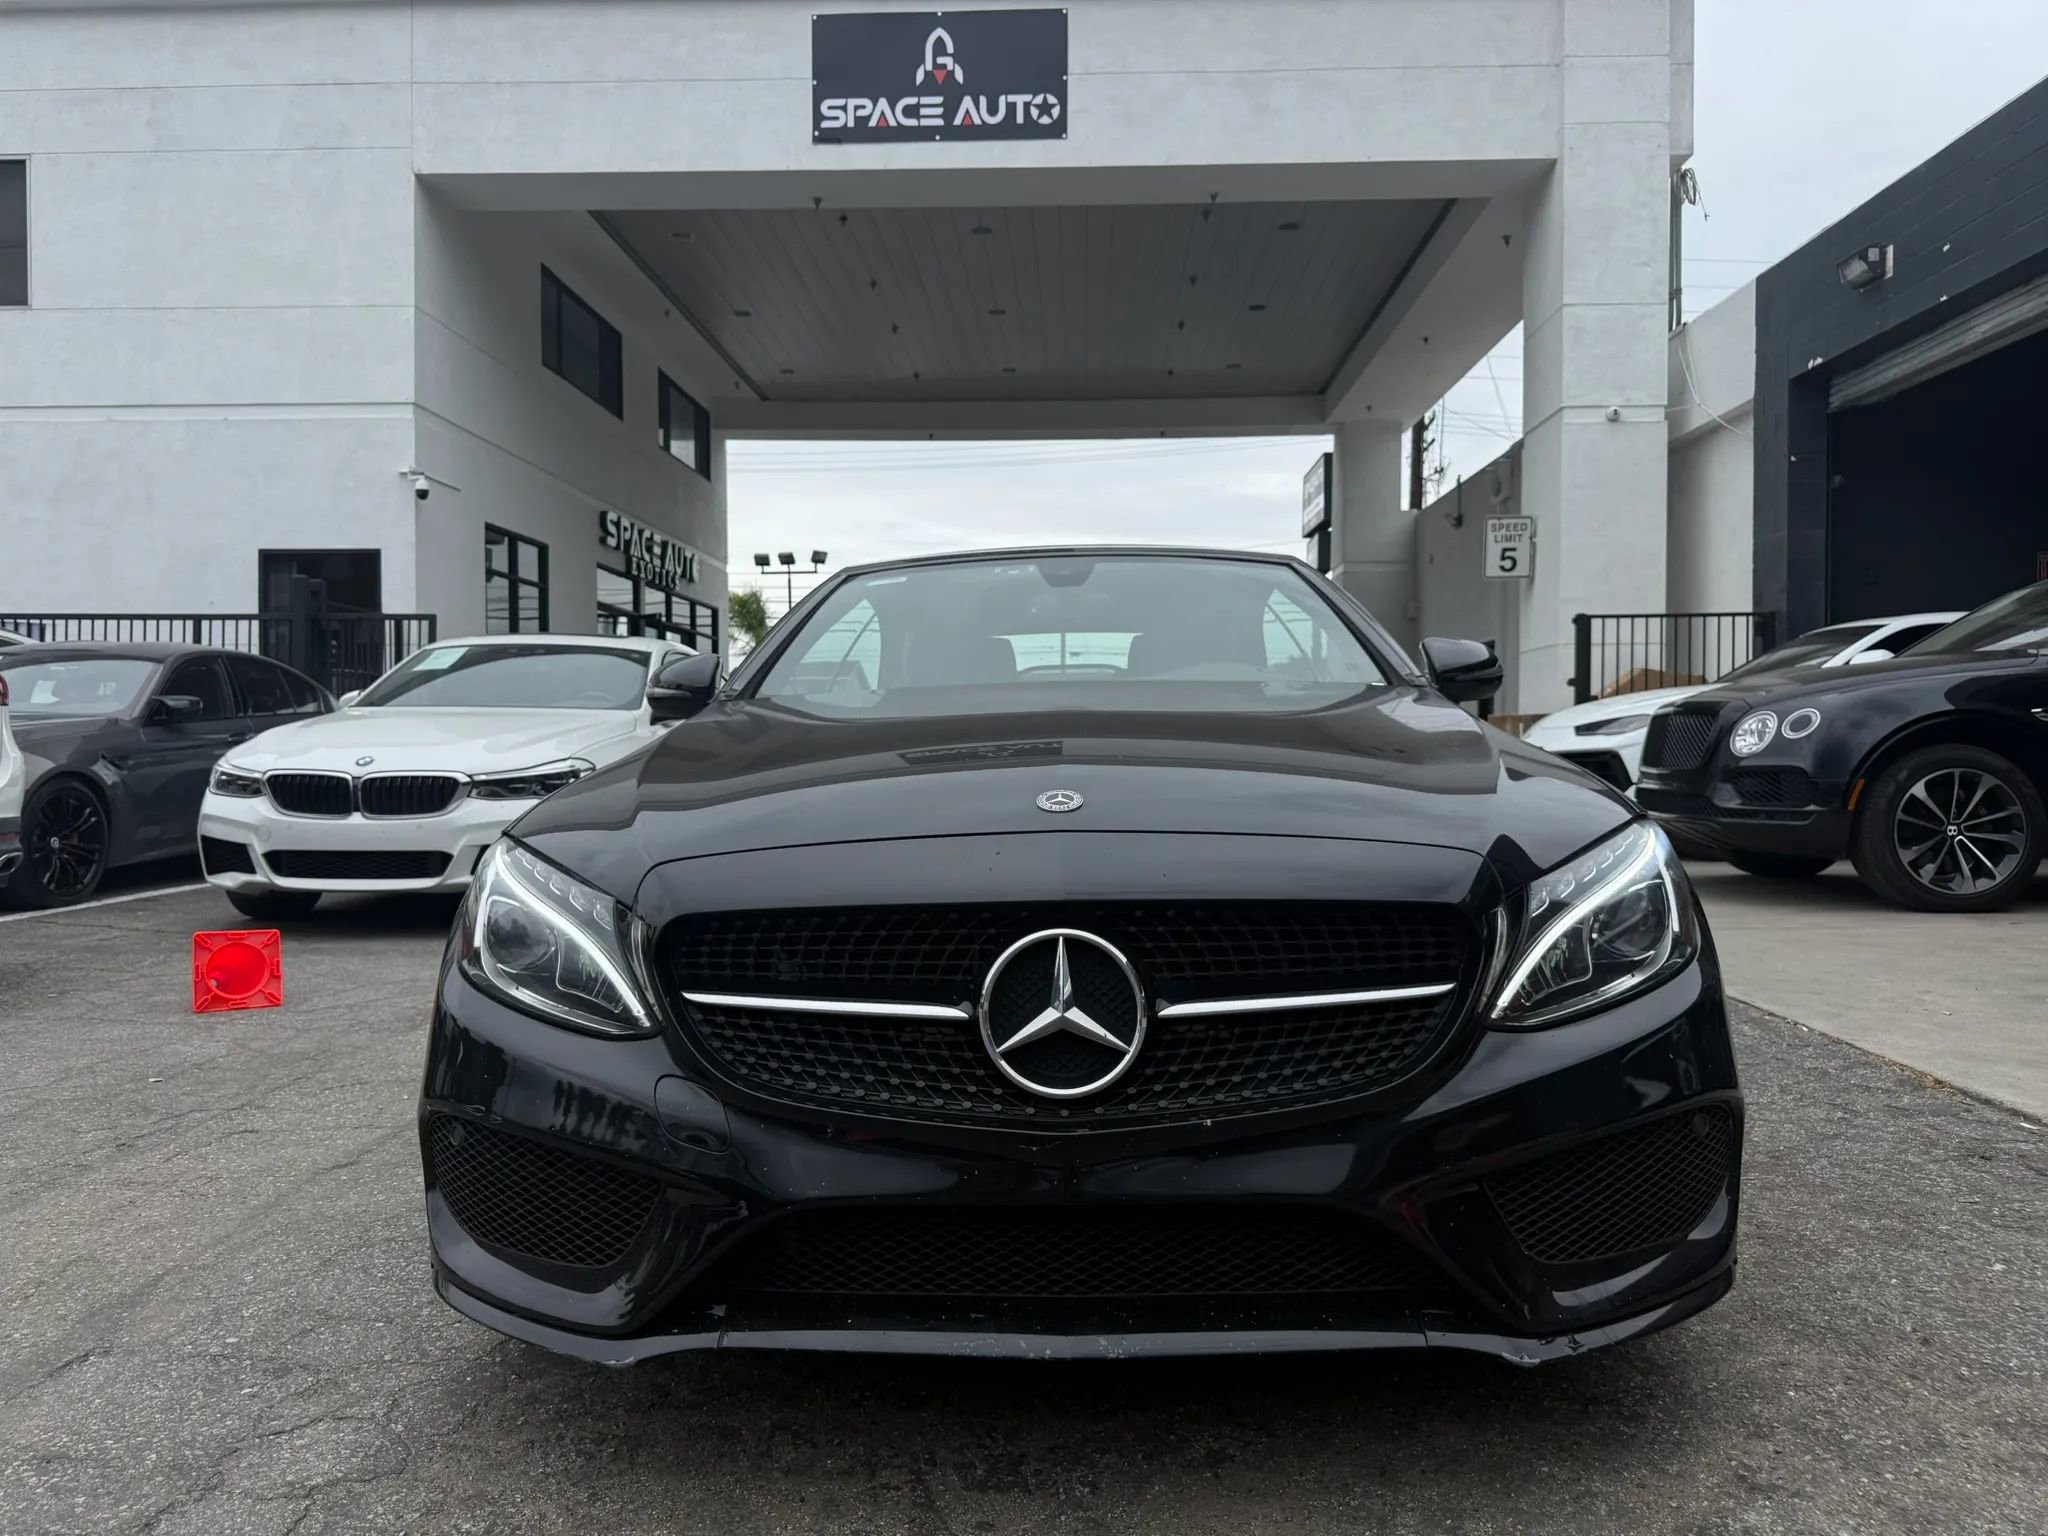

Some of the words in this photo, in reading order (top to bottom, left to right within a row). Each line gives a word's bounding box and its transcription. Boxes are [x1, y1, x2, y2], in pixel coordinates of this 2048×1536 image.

[820, 96, 945, 128] SPACE
[953, 93, 1061, 126] AUTO
[601, 510, 662, 568] SPACE
[1490, 522, 1528, 533] SPEED
[1494, 533, 1523, 544] LIMIT
[631, 557, 680, 591] EXOTICS
[1499, 547, 1517, 572] 5
